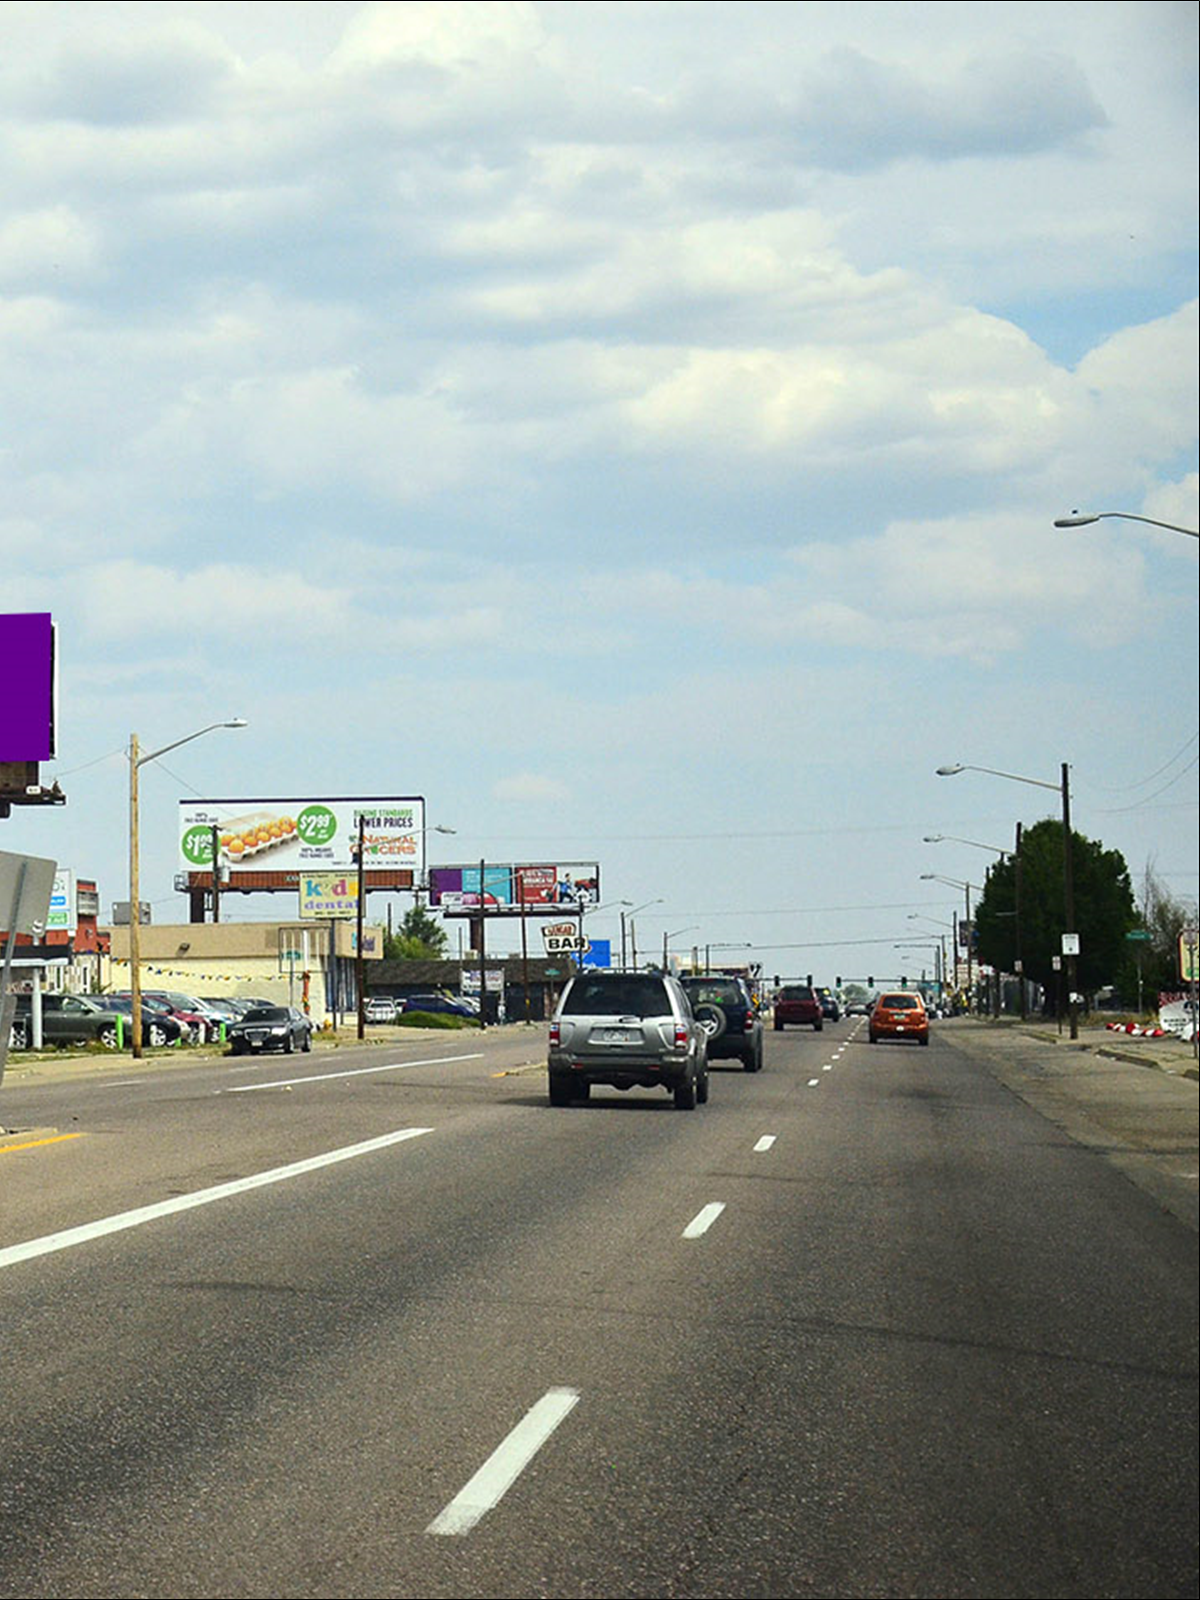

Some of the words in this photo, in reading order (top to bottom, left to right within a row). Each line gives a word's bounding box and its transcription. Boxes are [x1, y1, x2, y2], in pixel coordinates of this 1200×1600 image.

[353, 817, 381, 828] LWER
[384, 816, 413, 828] PRICES
[548, 937, 586, 949] BAR
